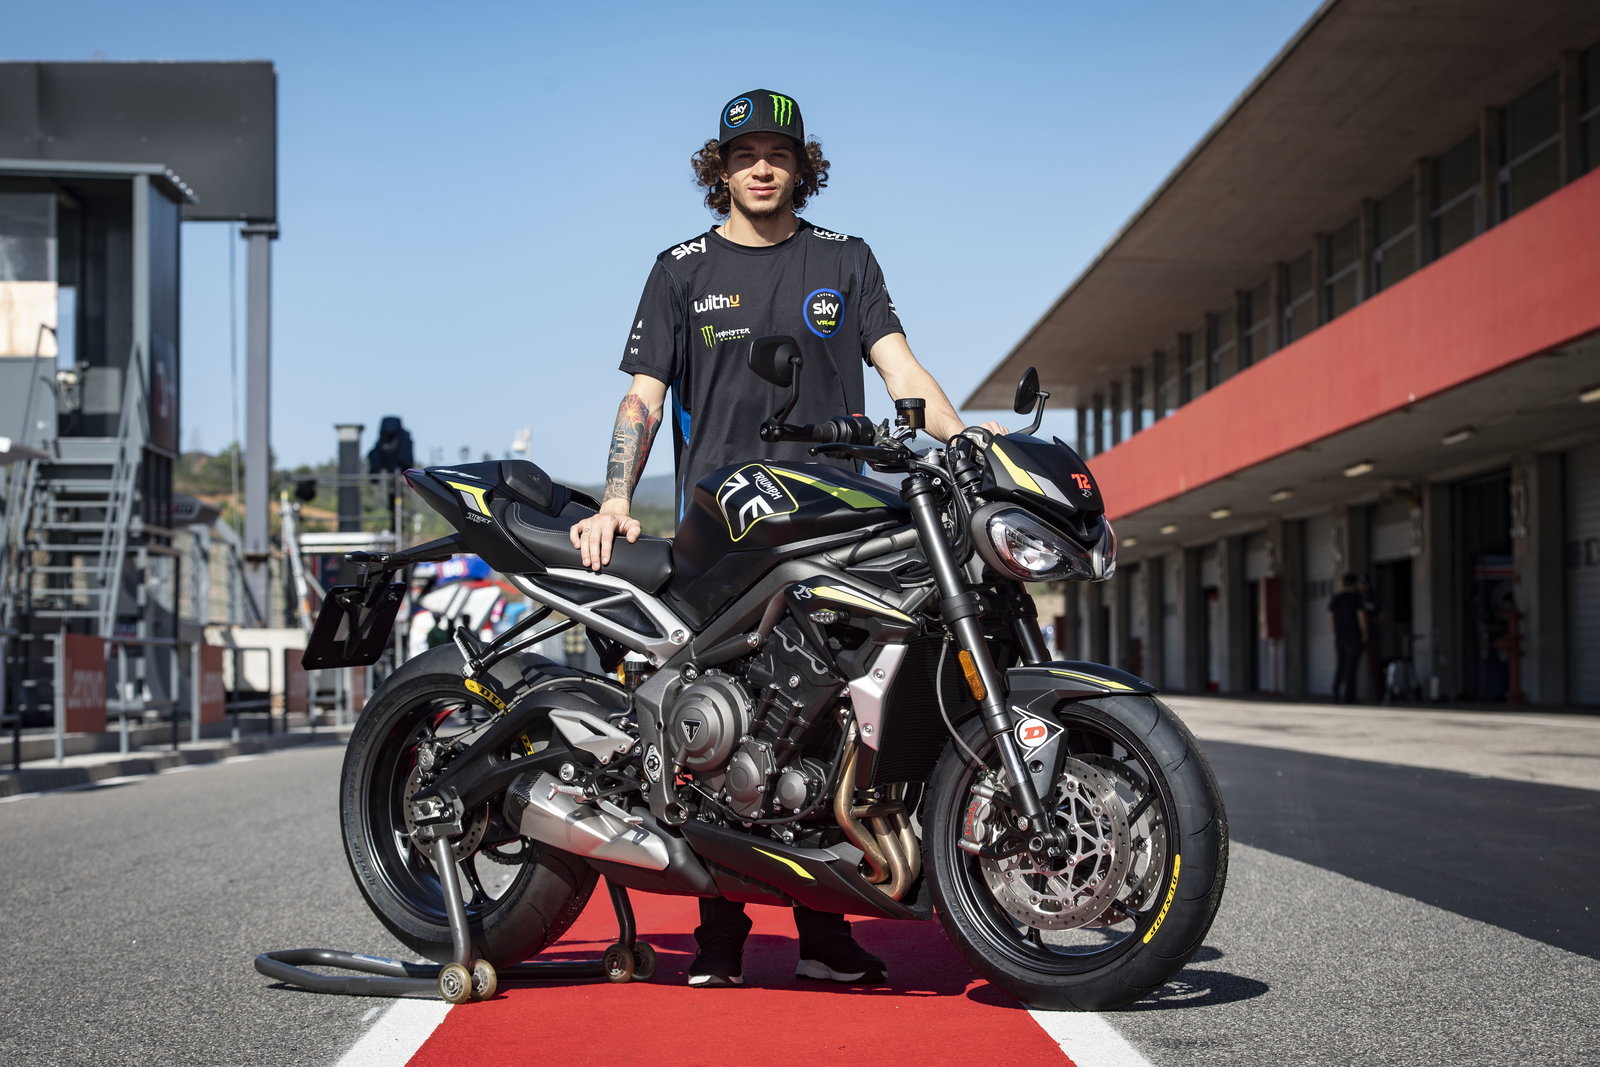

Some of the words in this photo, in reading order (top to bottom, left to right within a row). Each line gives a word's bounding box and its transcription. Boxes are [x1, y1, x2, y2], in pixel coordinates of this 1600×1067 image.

[670, 237, 707, 260] sky
[812, 299, 840, 319] sky
[752, 471, 783, 500] TRIUMPH
[1070, 473, 1093, 489] 72
[1023, 725, 1047, 741] D
[1149, 874, 1178, 936] DUNLOP
